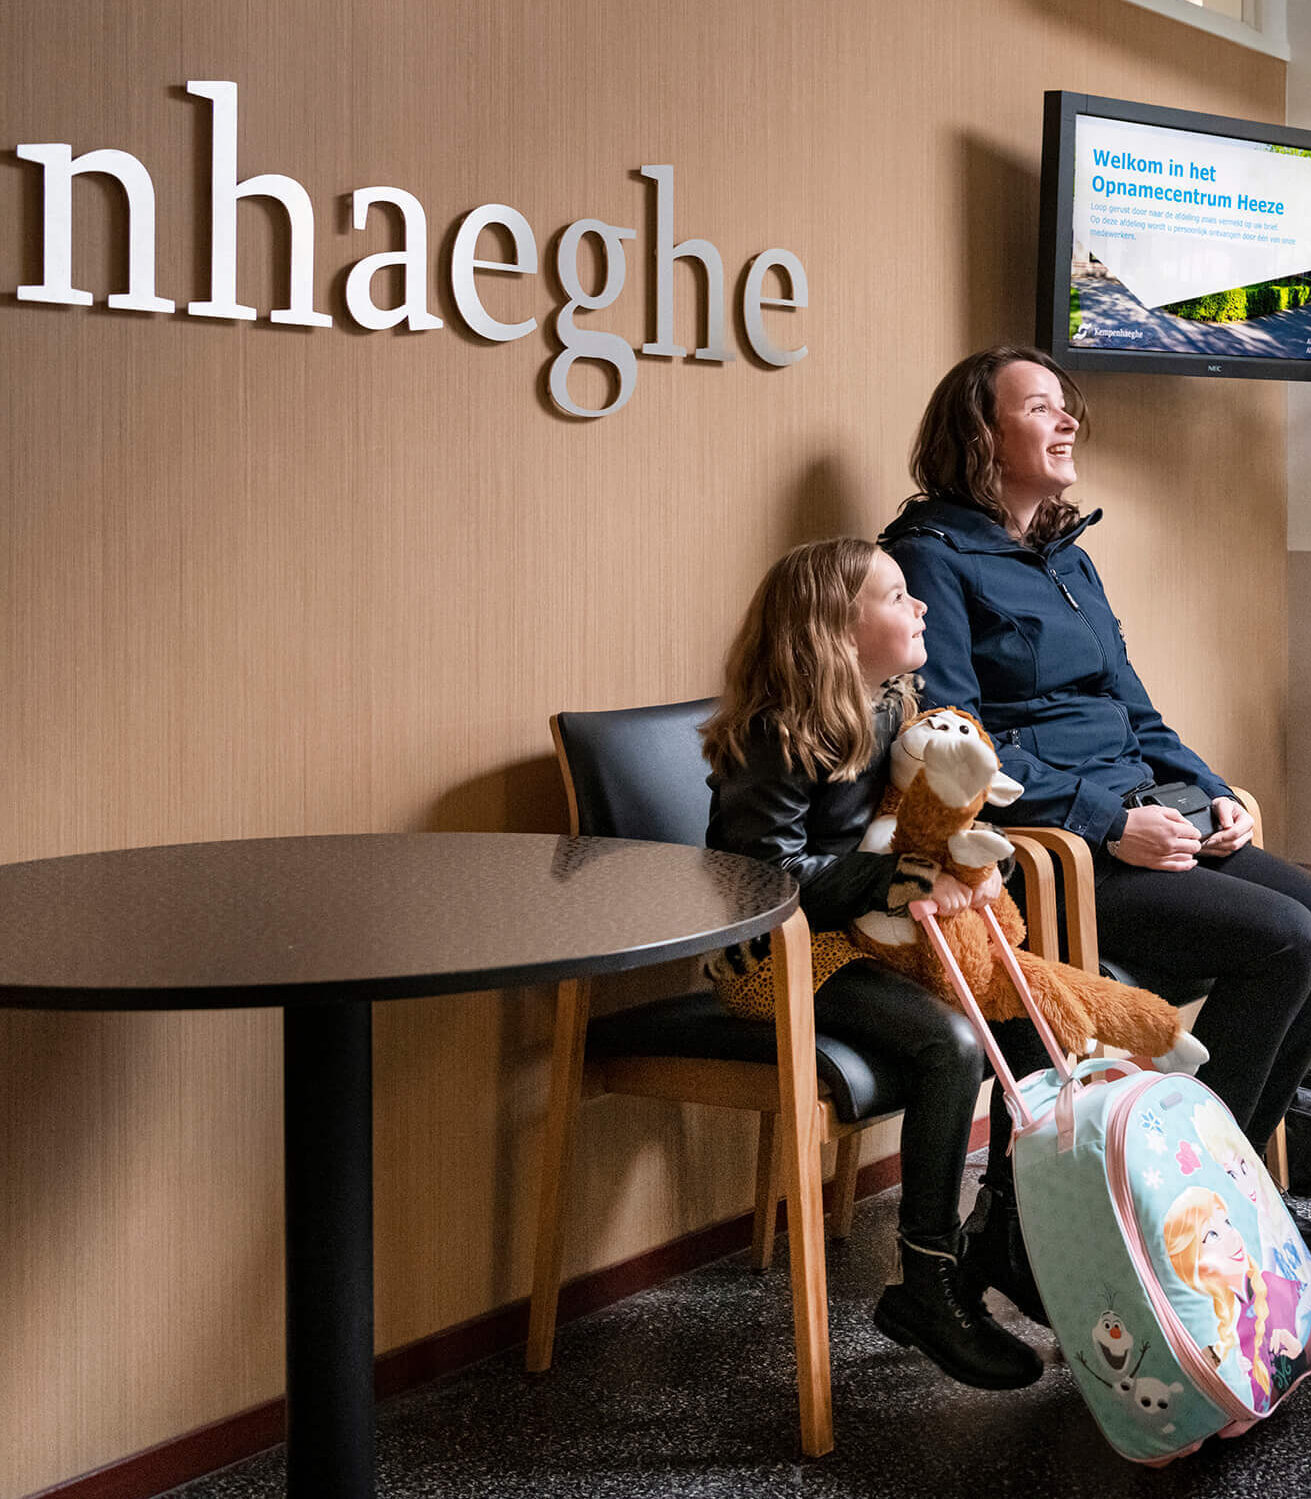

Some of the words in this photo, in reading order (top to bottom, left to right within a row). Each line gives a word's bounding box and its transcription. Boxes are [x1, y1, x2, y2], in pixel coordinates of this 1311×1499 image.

[1093, 148, 1163, 175] Welkom
[1169, 158, 1184, 178] in
[1190, 161, 1217, 182] het
[1090, 202, 1107, 213] Loop
[1109, 205, 1130, 214] gerust
[1132, 206, 1147, 216] door
[1149, 210, 1163, 218] naar
[1165, 211, 1173, 219] de
[1092, 175, 1232, 209] Opnamecentrum
[1237, 194, 1285, 215] Heeze
[1090, 215, 1100, 225] Op
[1102, 217, 1118, 226] deze
[1120, 218, 1146, 230] afdeling
[16, 80, 810, 418] nhaeghe
